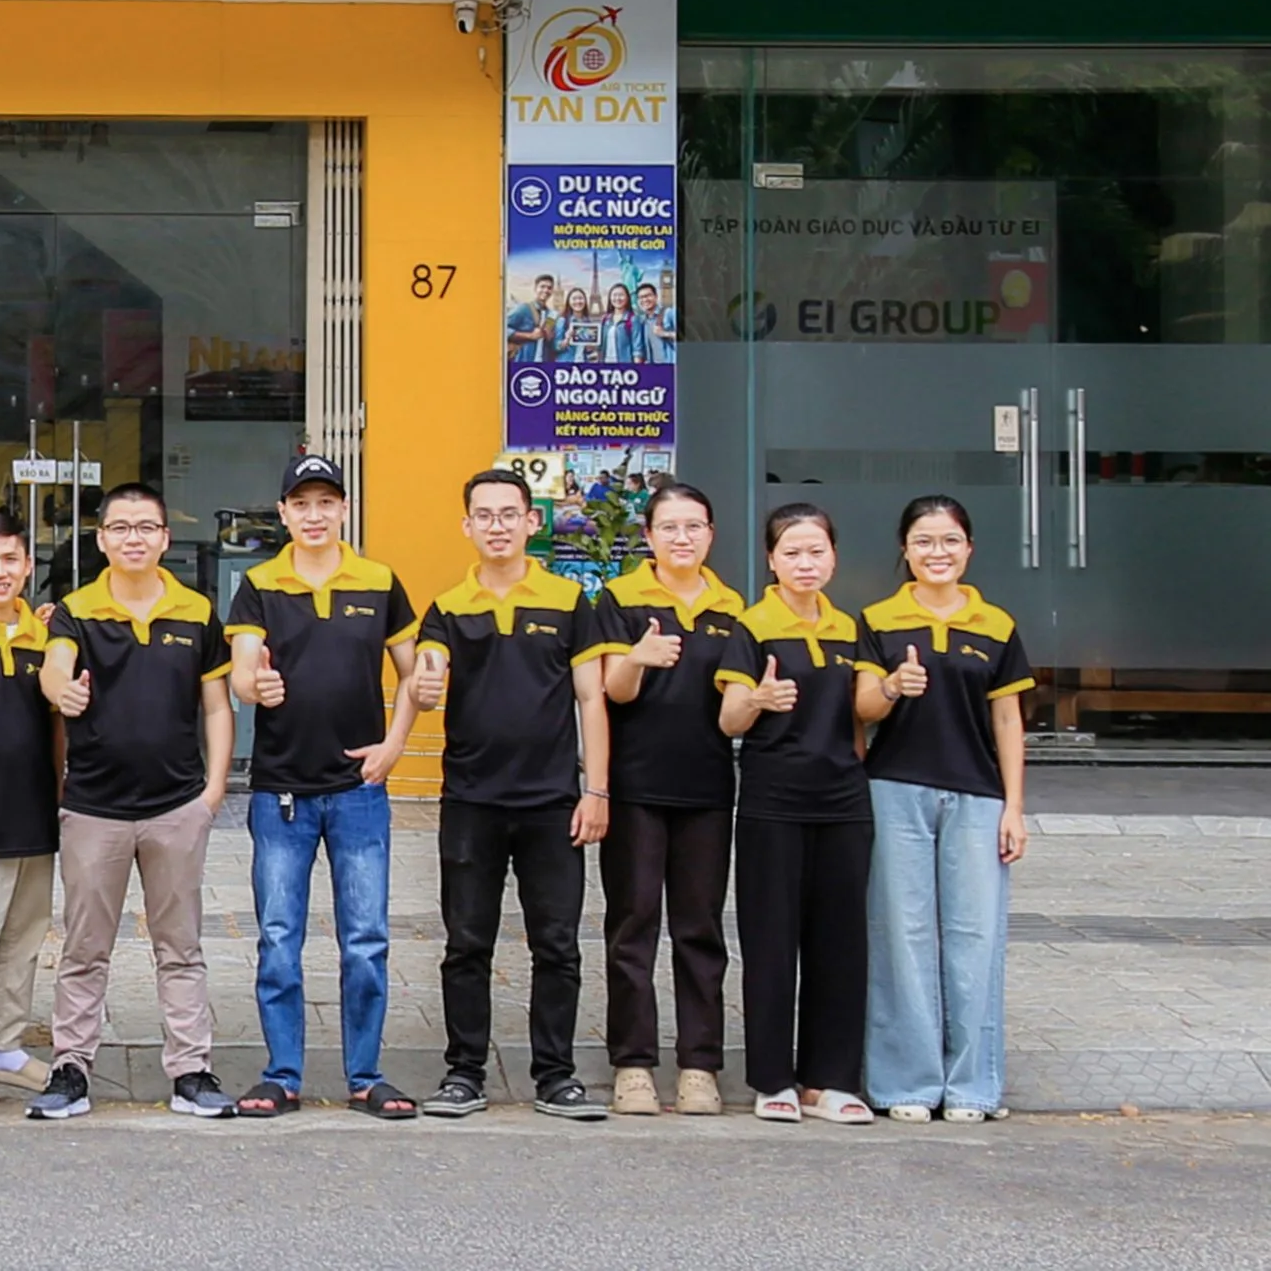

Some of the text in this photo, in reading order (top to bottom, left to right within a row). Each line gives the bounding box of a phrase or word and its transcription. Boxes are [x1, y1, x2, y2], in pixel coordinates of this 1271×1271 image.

[625, 83, 667, 91] TICKET
[559, 176, 643, 199] DU HỌC
[559, 195, 671, 218] CÁC NƯỚC
[412, 265, 456, 299] 87
[798, 300, 1002, 334] EI GROUP
[555, 366, 638, 390] ĐÀO TẠO
[555, 387, 666, 409] NGOẠI NGỮ
[511, 458, 548, 482] 89
